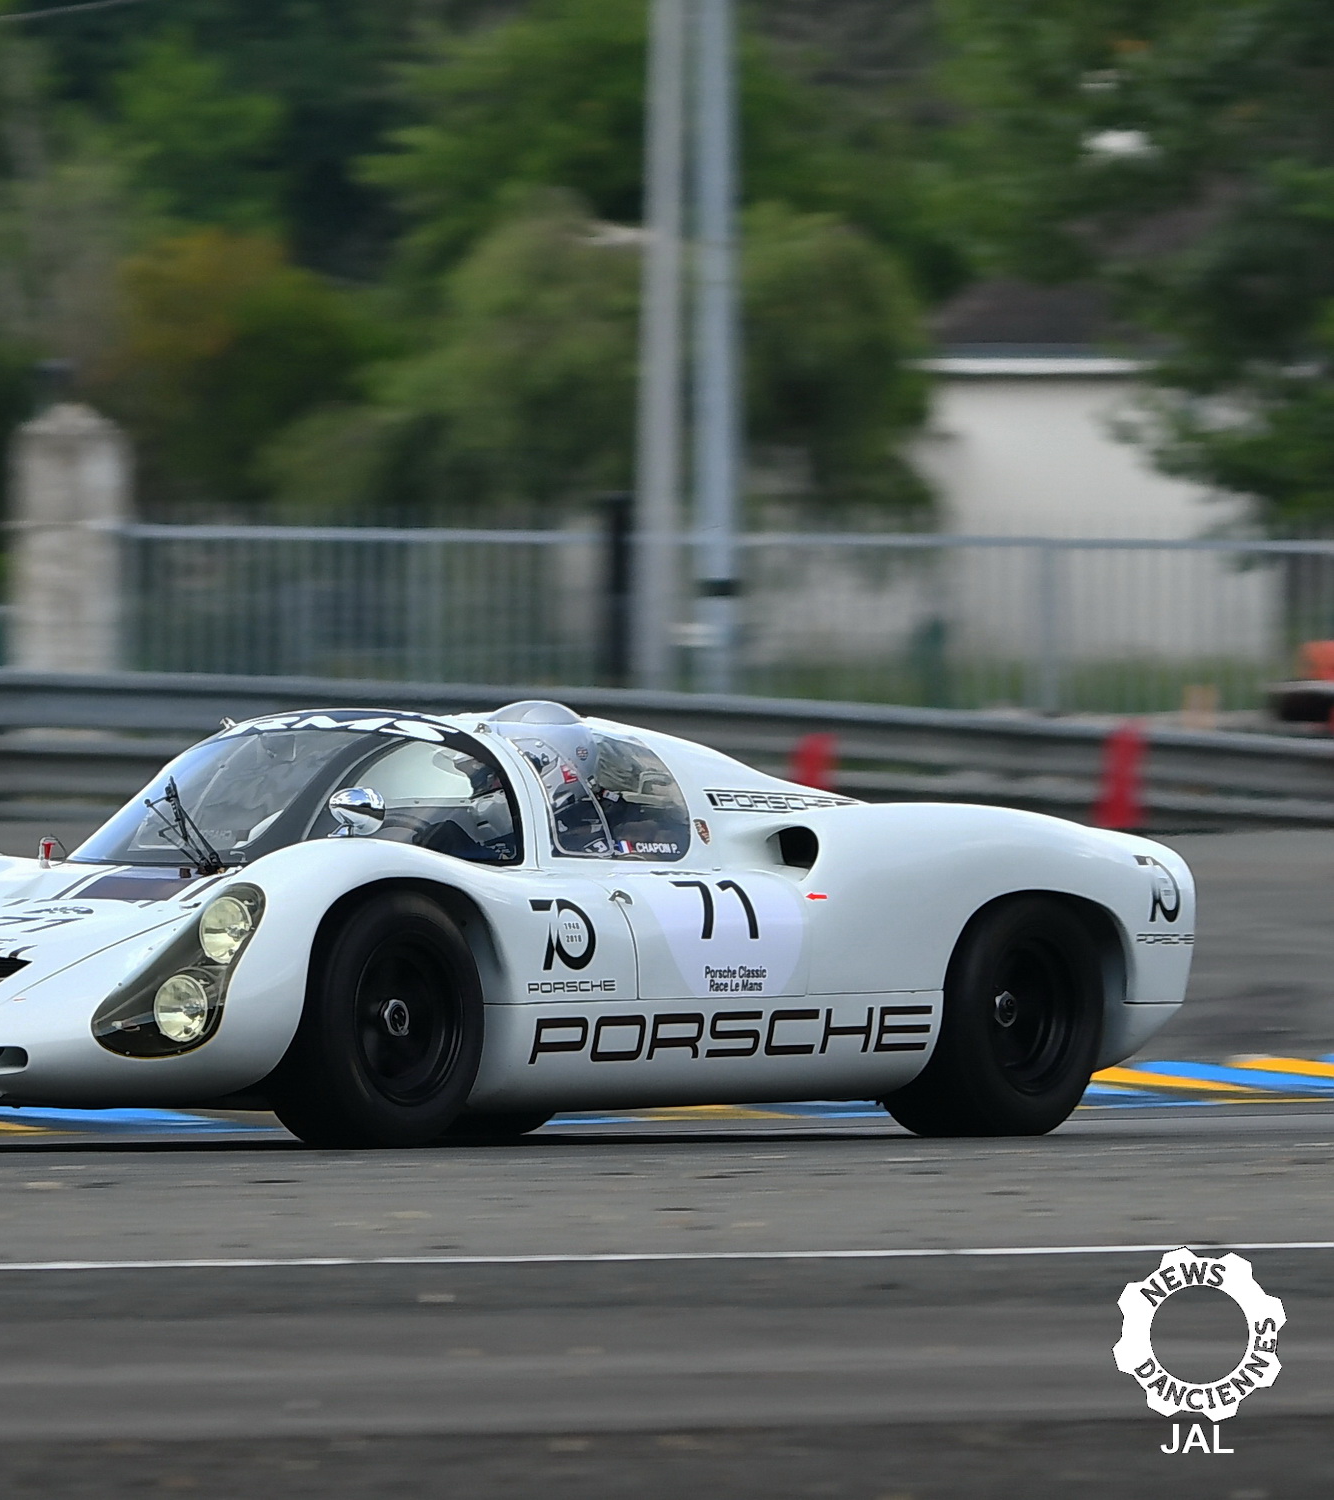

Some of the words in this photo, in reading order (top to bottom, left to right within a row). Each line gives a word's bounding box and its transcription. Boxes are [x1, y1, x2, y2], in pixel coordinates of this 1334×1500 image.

[217, 715, 461, 742] RMS
[716, 793, 836, 810] PORSCHE
[636, 842, 671, 853] CHAPON
[668, 880, 759, 939] 71
[528, 898, 596, 970] 70
[705, 966, 737, 979] Porsche
[738, 966, 767, 979] Classic
[527, 980, 616, 994] PORSCHE
[709, 980, 729, 992] Race
[730, 980, 740, 992] Le
[741, 980, 763, 992] Mans
[528, 1005, 933, 1064] PORSCHE
